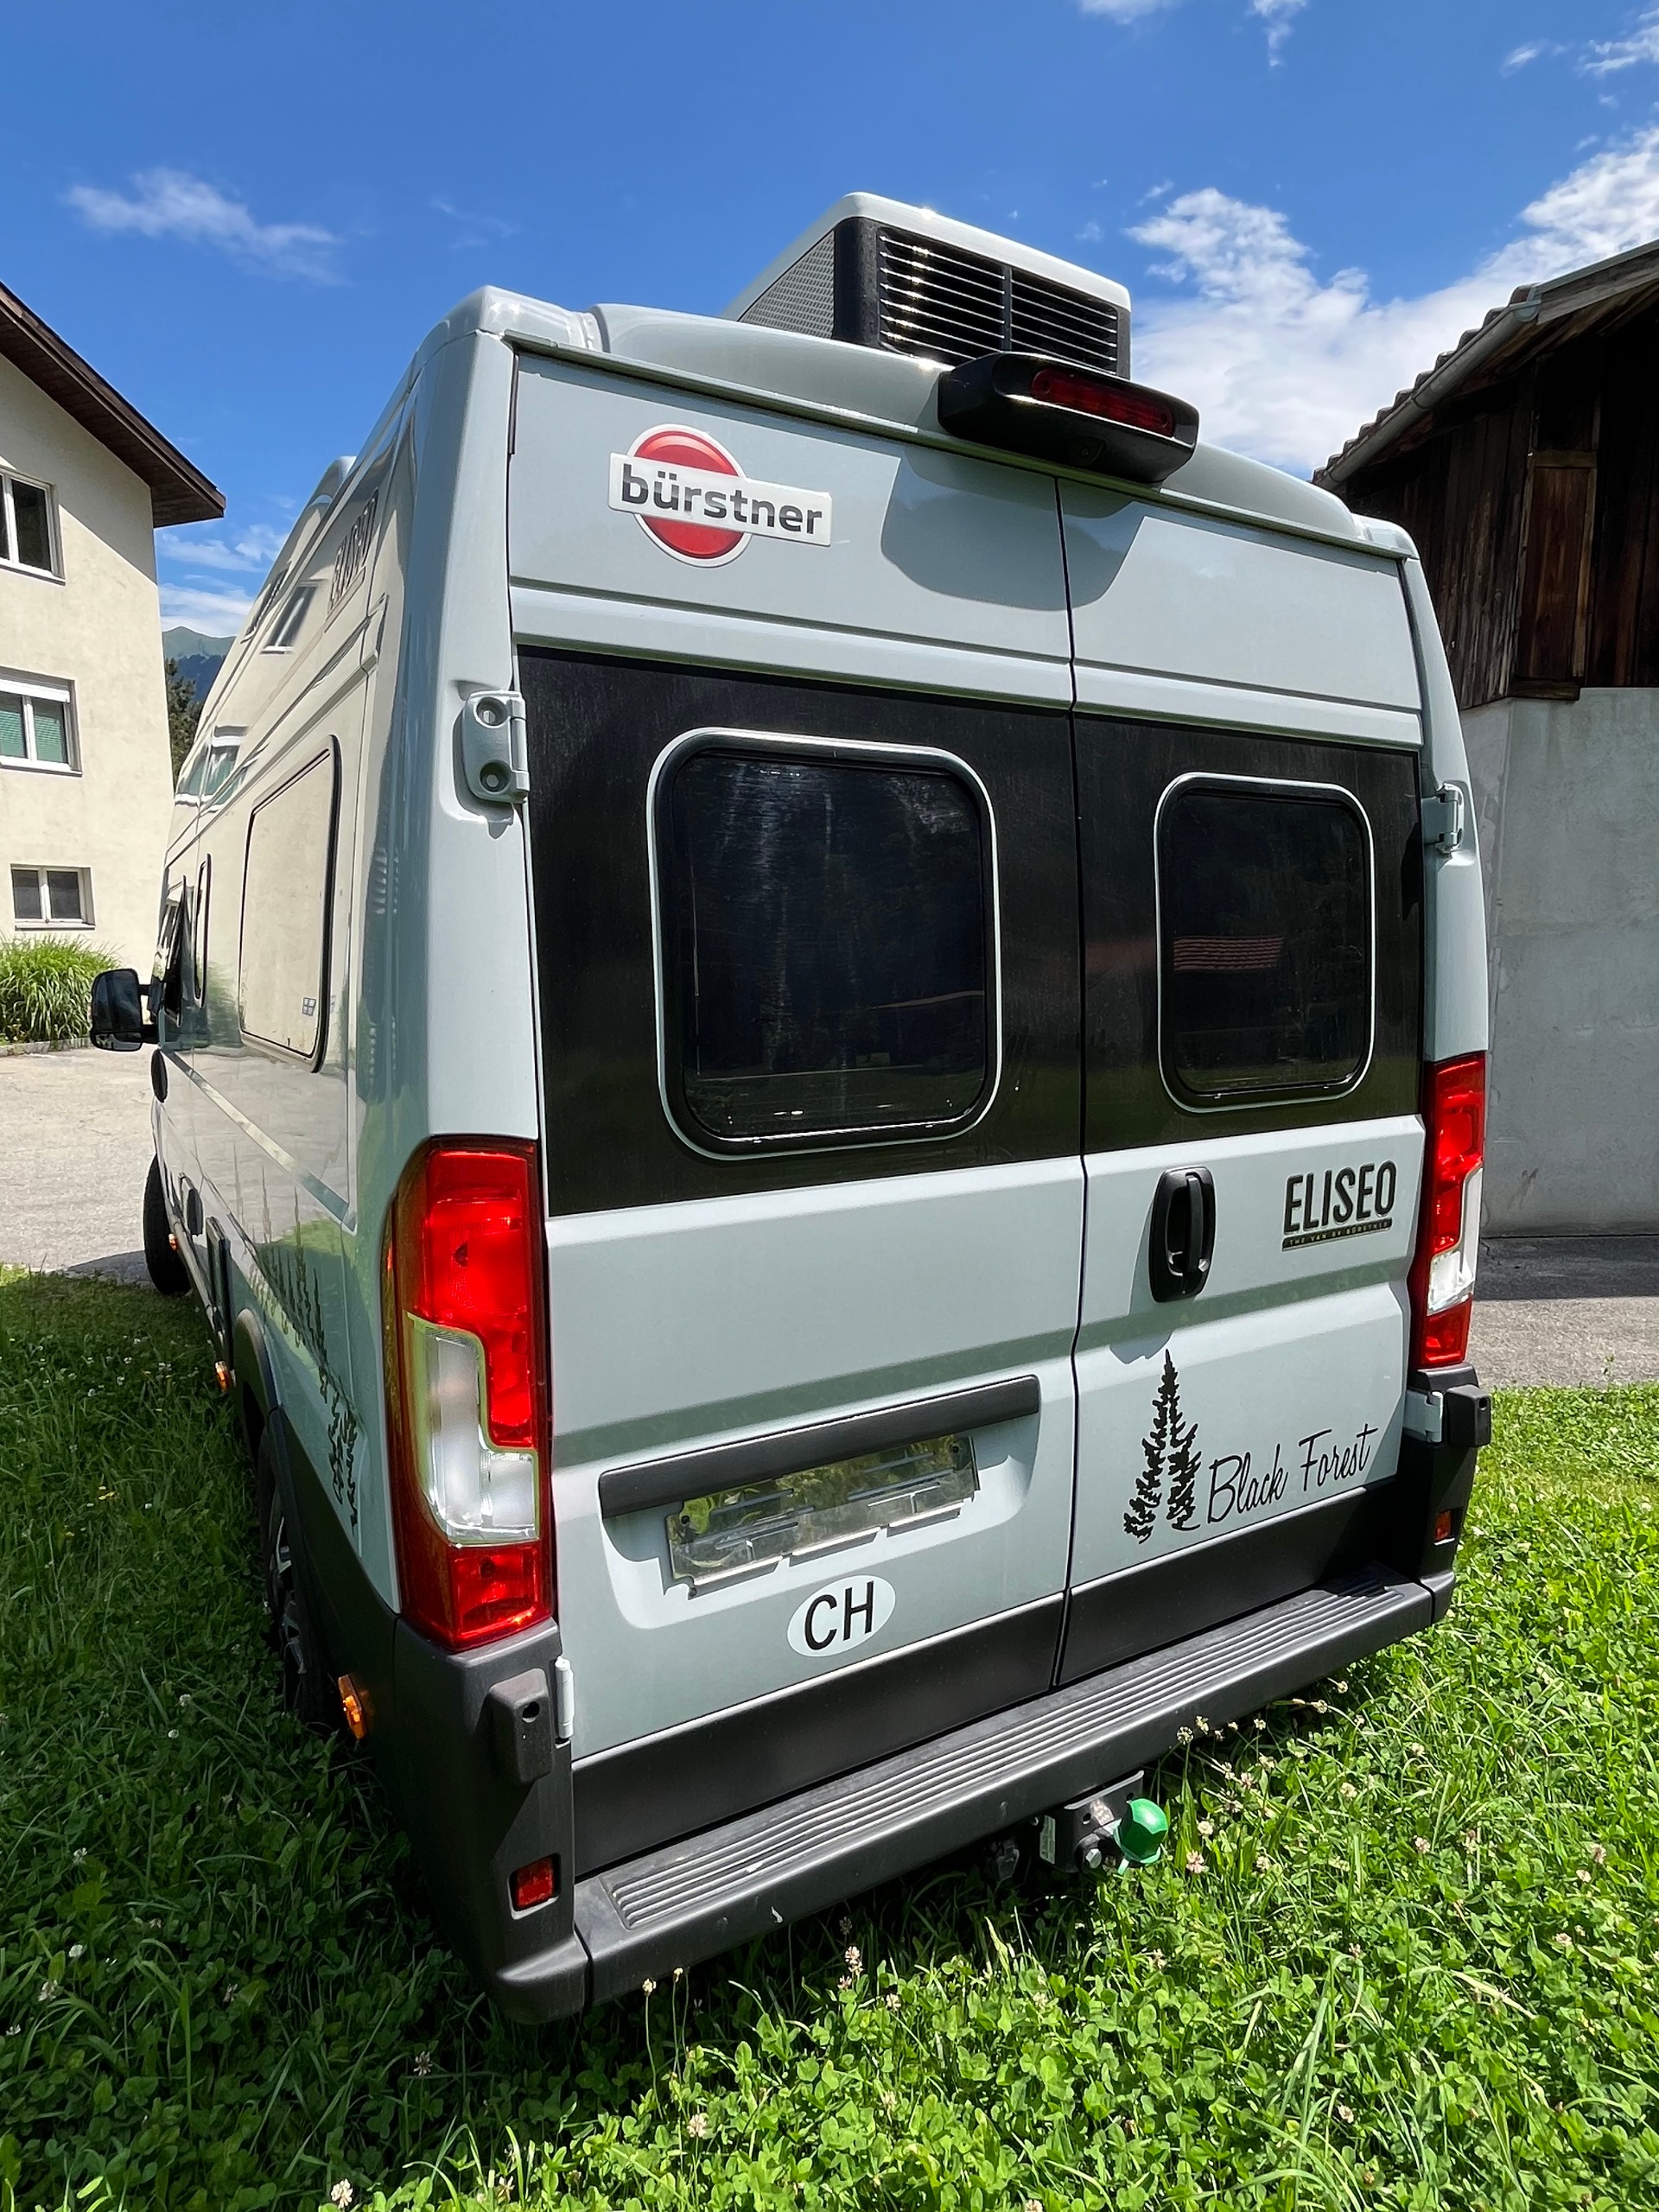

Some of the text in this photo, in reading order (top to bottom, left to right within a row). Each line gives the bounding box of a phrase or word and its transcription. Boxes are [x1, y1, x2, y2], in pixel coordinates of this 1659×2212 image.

[621, 463, 823, 535] bürstner
[1284, 1160, 1397, 1233] ELISEO
[1310, 1233, 1328, 1243] VAN
[1207, 1423, 1378, 1524] Black Forest
[804, 1580, 874, 1651] CH
